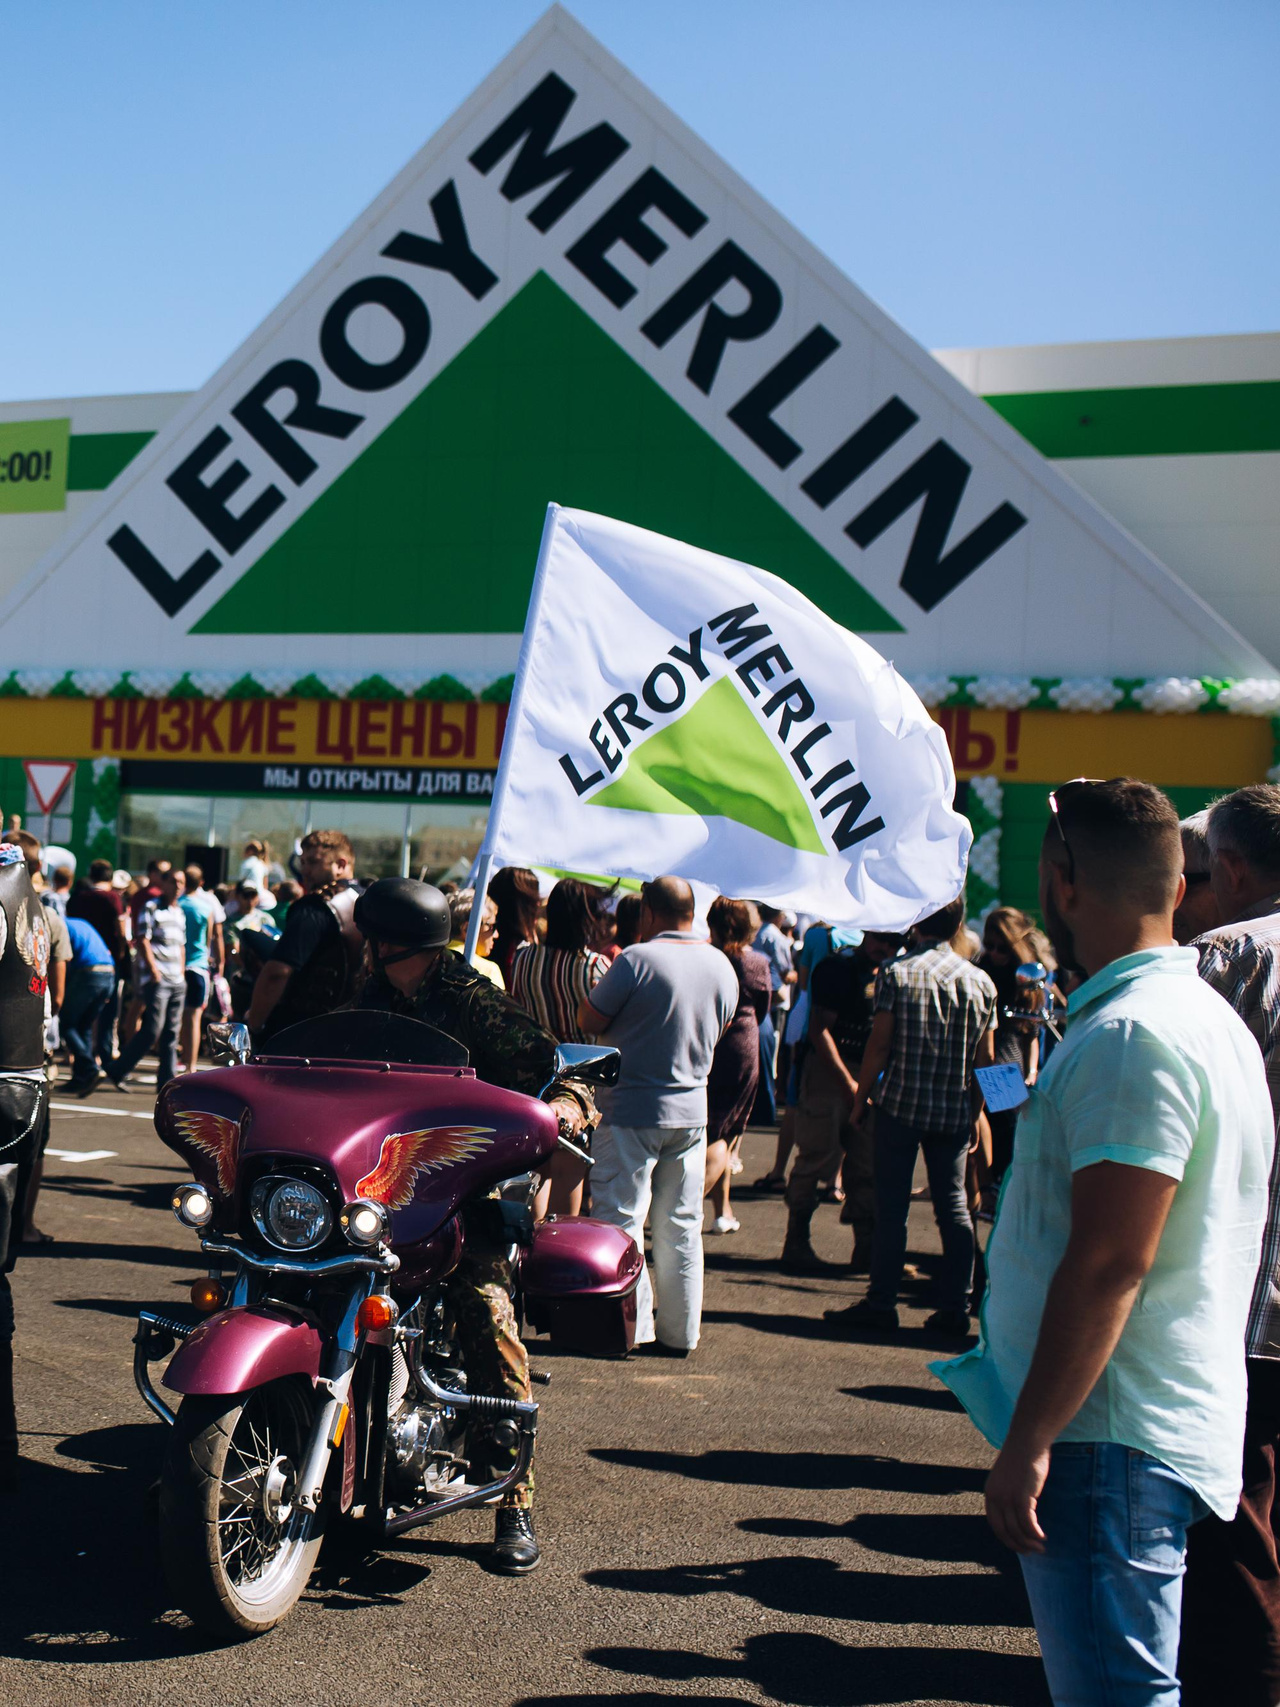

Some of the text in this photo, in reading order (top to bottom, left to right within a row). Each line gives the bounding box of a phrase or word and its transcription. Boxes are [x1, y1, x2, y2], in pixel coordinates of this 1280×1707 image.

[106, 178, 500, 618] LEROY
[467, 70, 1028, 614] MERLIN
[91, 699, 297, 755] НИЗКИЕ
[316, 702, 478, 762] ЦЕНЫ
[264, 769, 300, 788] МЫ
[308, 769, 412, 792] ОТКРЫТЫ
[417, 771, 461, 796] ДЛЯ
[558, 627, 711, 797] LEROY
[707, 602, 886, 852] MERLIN
